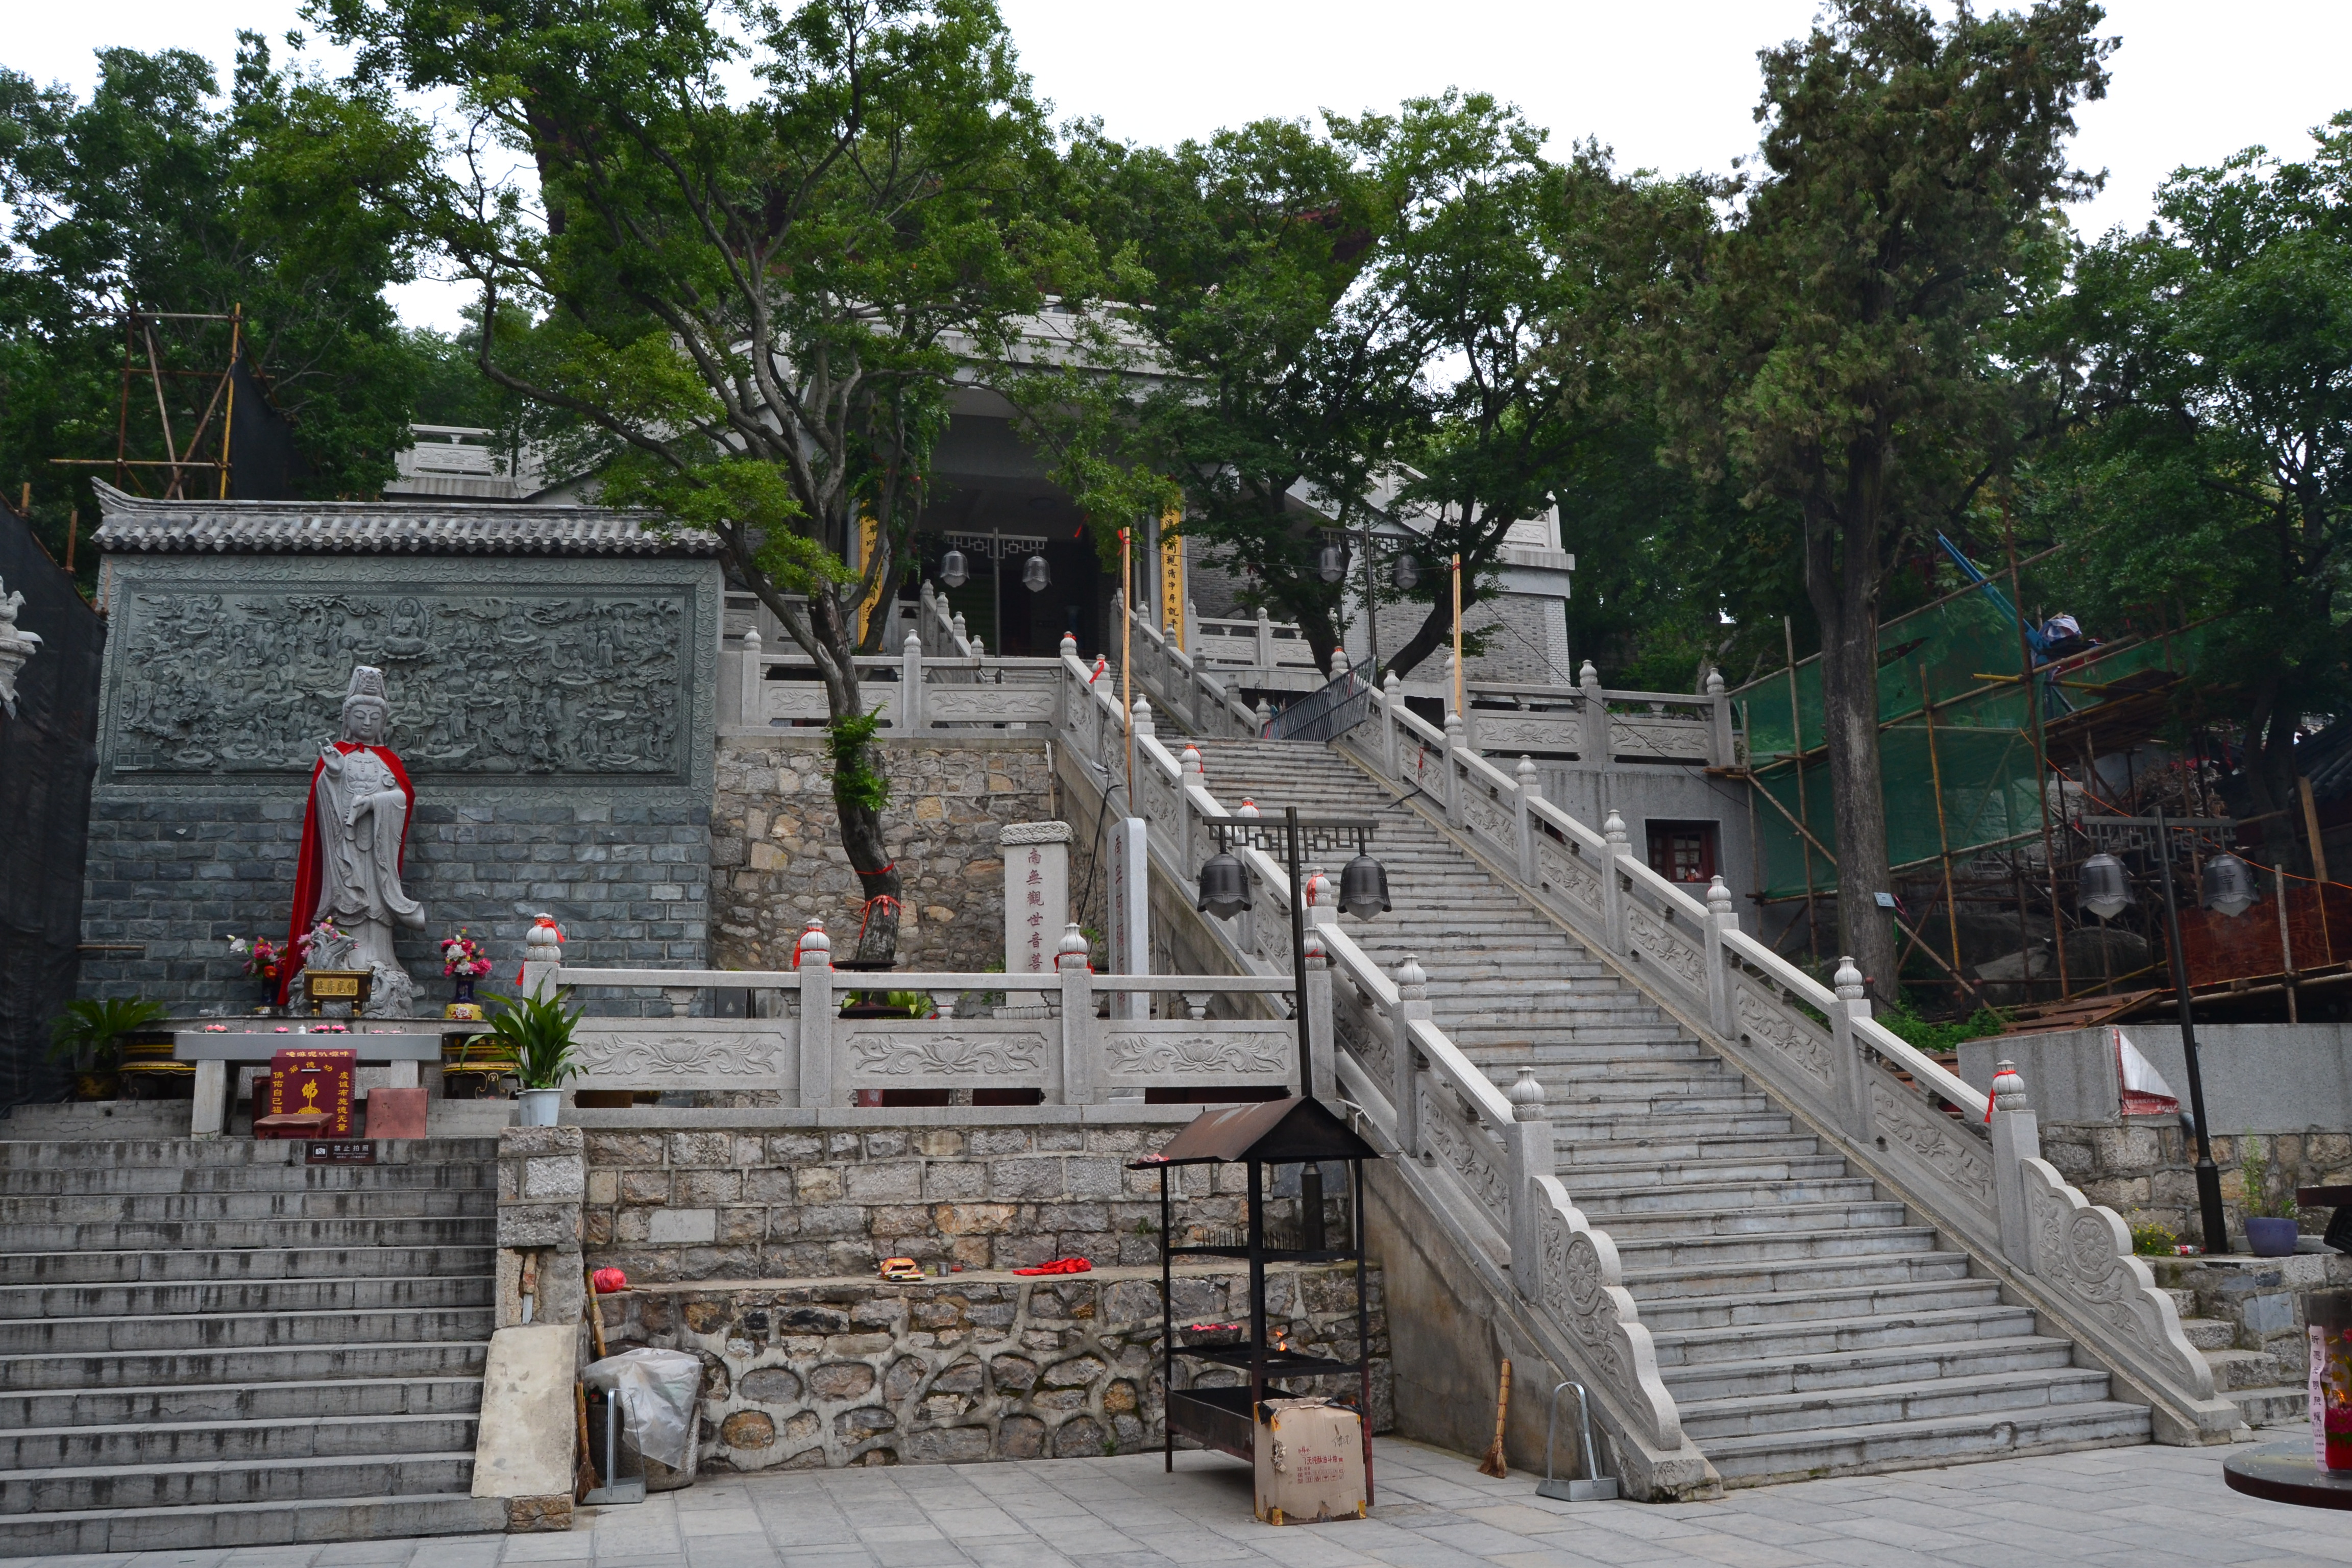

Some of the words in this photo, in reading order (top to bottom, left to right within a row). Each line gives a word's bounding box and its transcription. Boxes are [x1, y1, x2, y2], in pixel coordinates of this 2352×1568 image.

[271, 1071, 284, 1114] 佛佑自己福
[336, 1071, 349, 1132] 虔诚布施德无量
